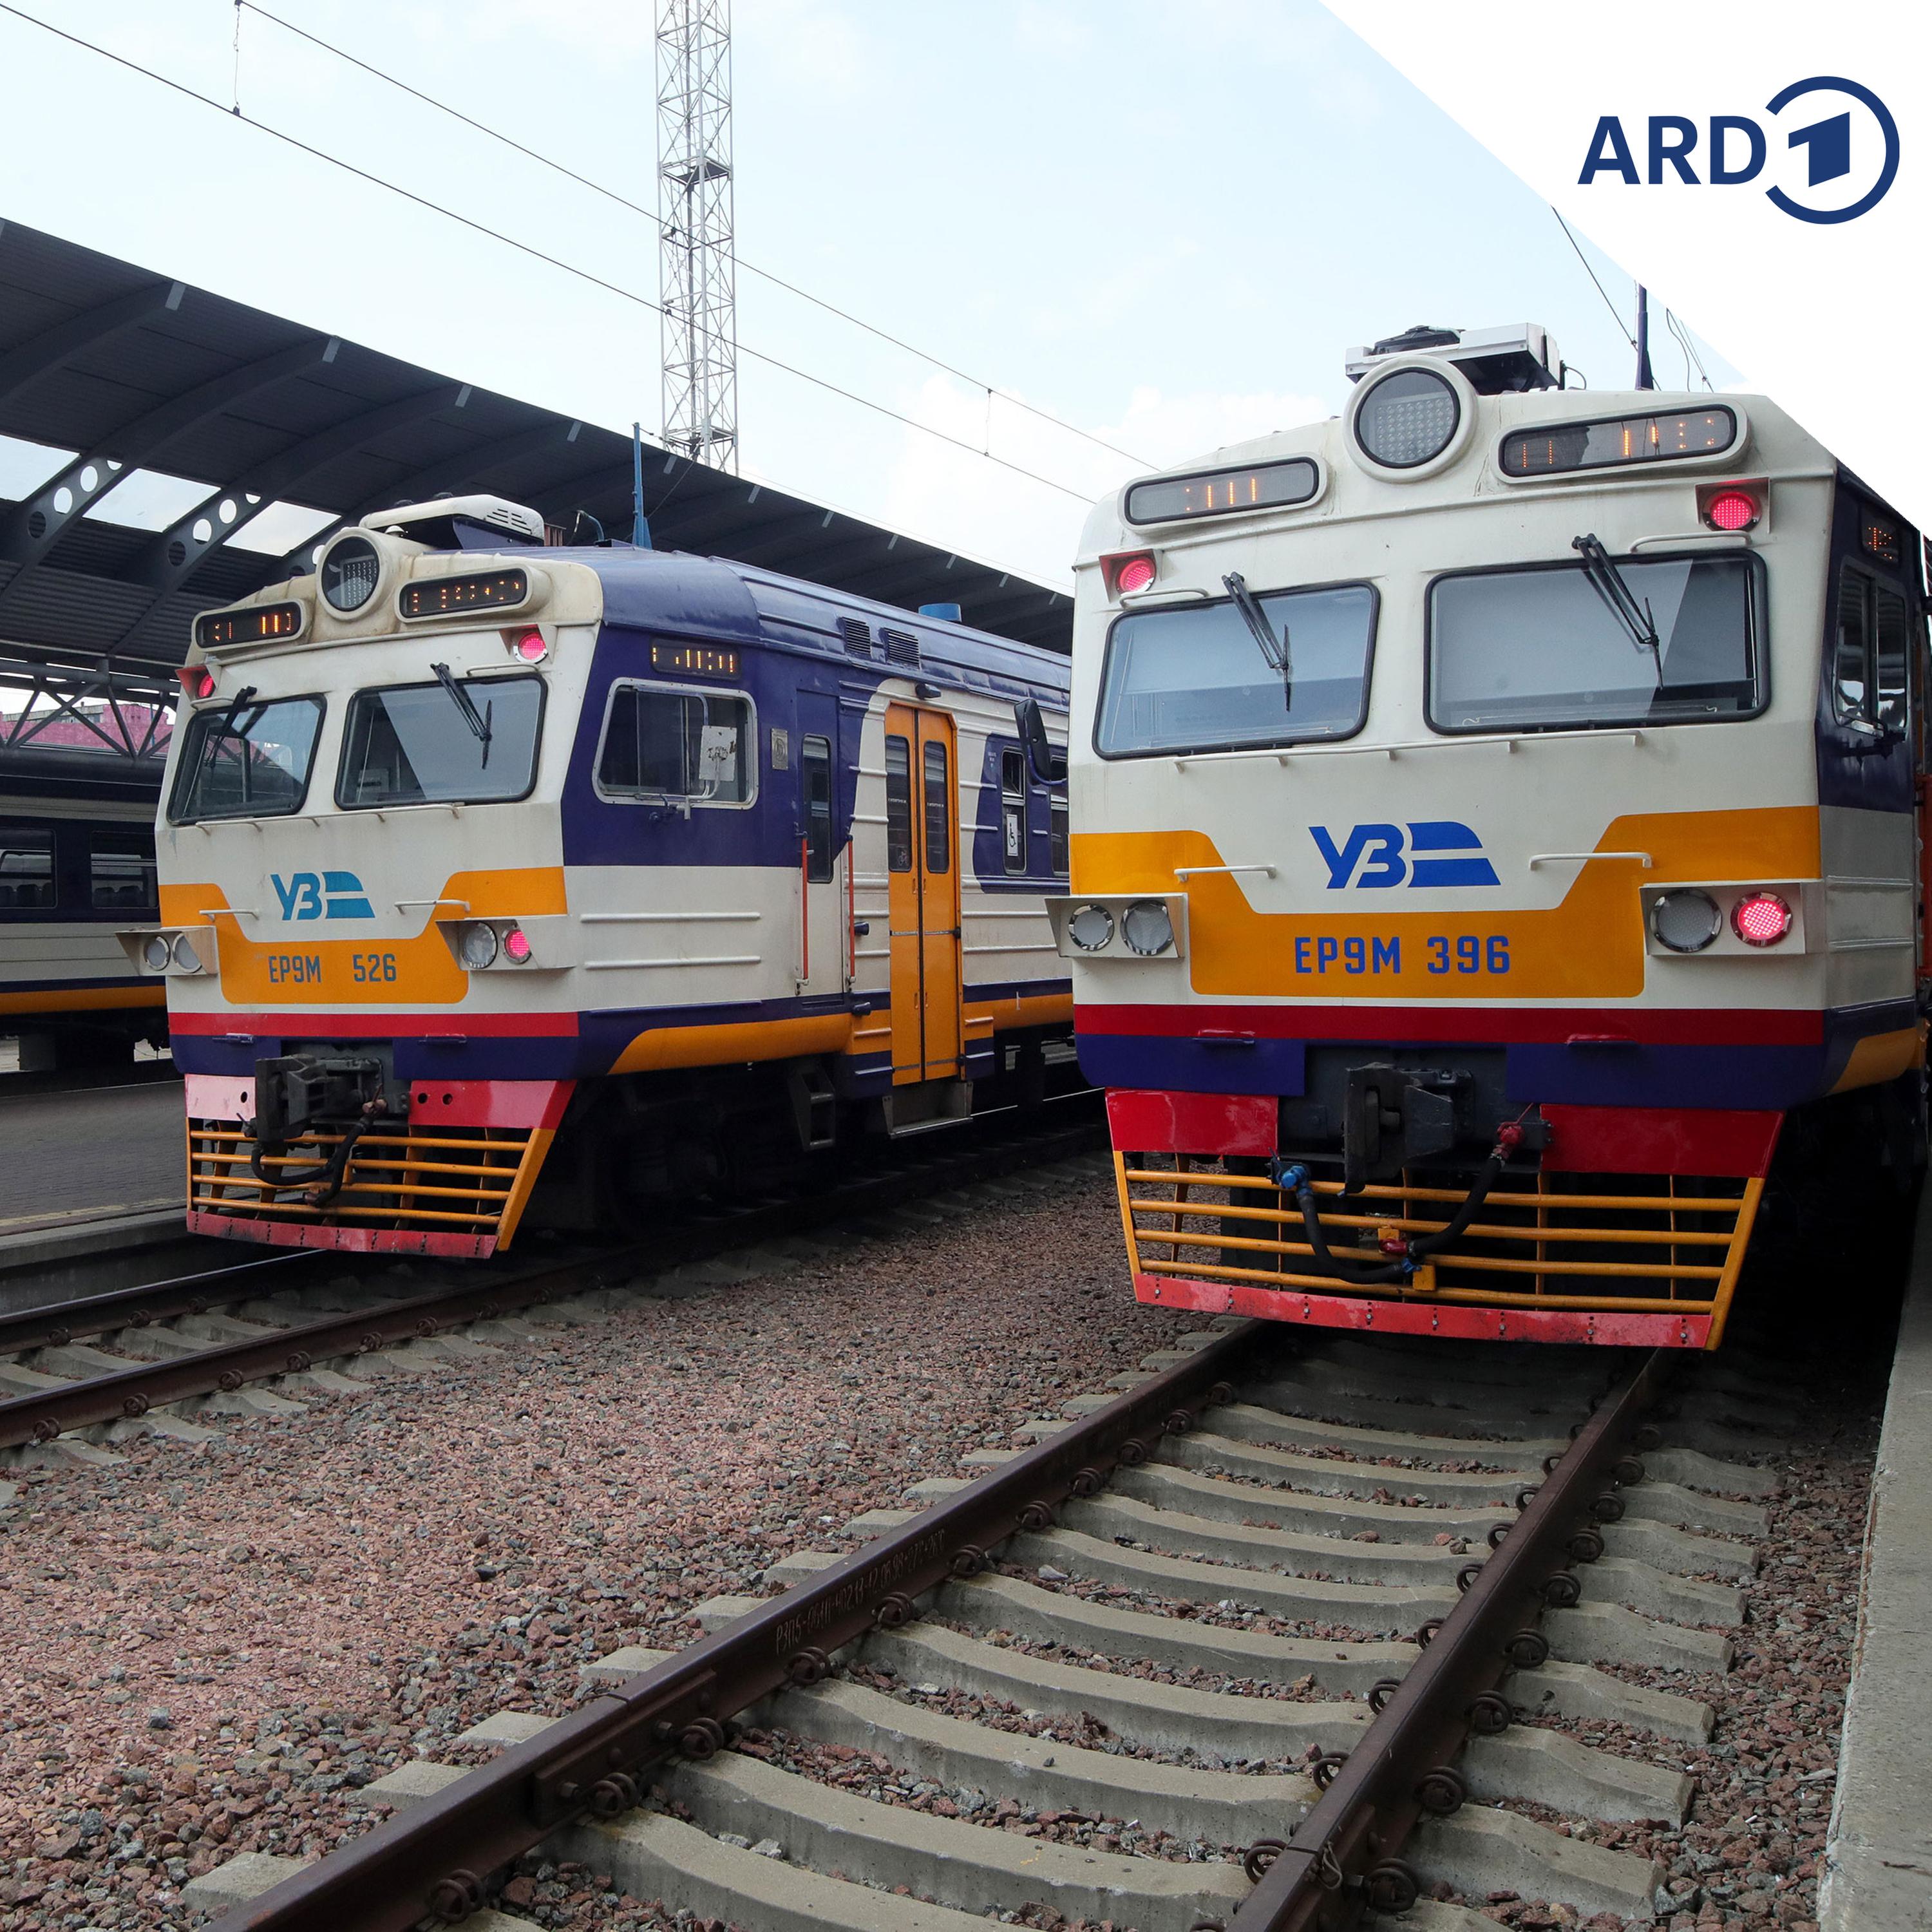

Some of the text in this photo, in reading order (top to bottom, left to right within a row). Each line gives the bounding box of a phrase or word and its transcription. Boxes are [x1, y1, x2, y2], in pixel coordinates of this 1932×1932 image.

[268, 953, 397, 983] ЕР9М 526
[1294, 935, 1511, 974] ЕР9М 396
